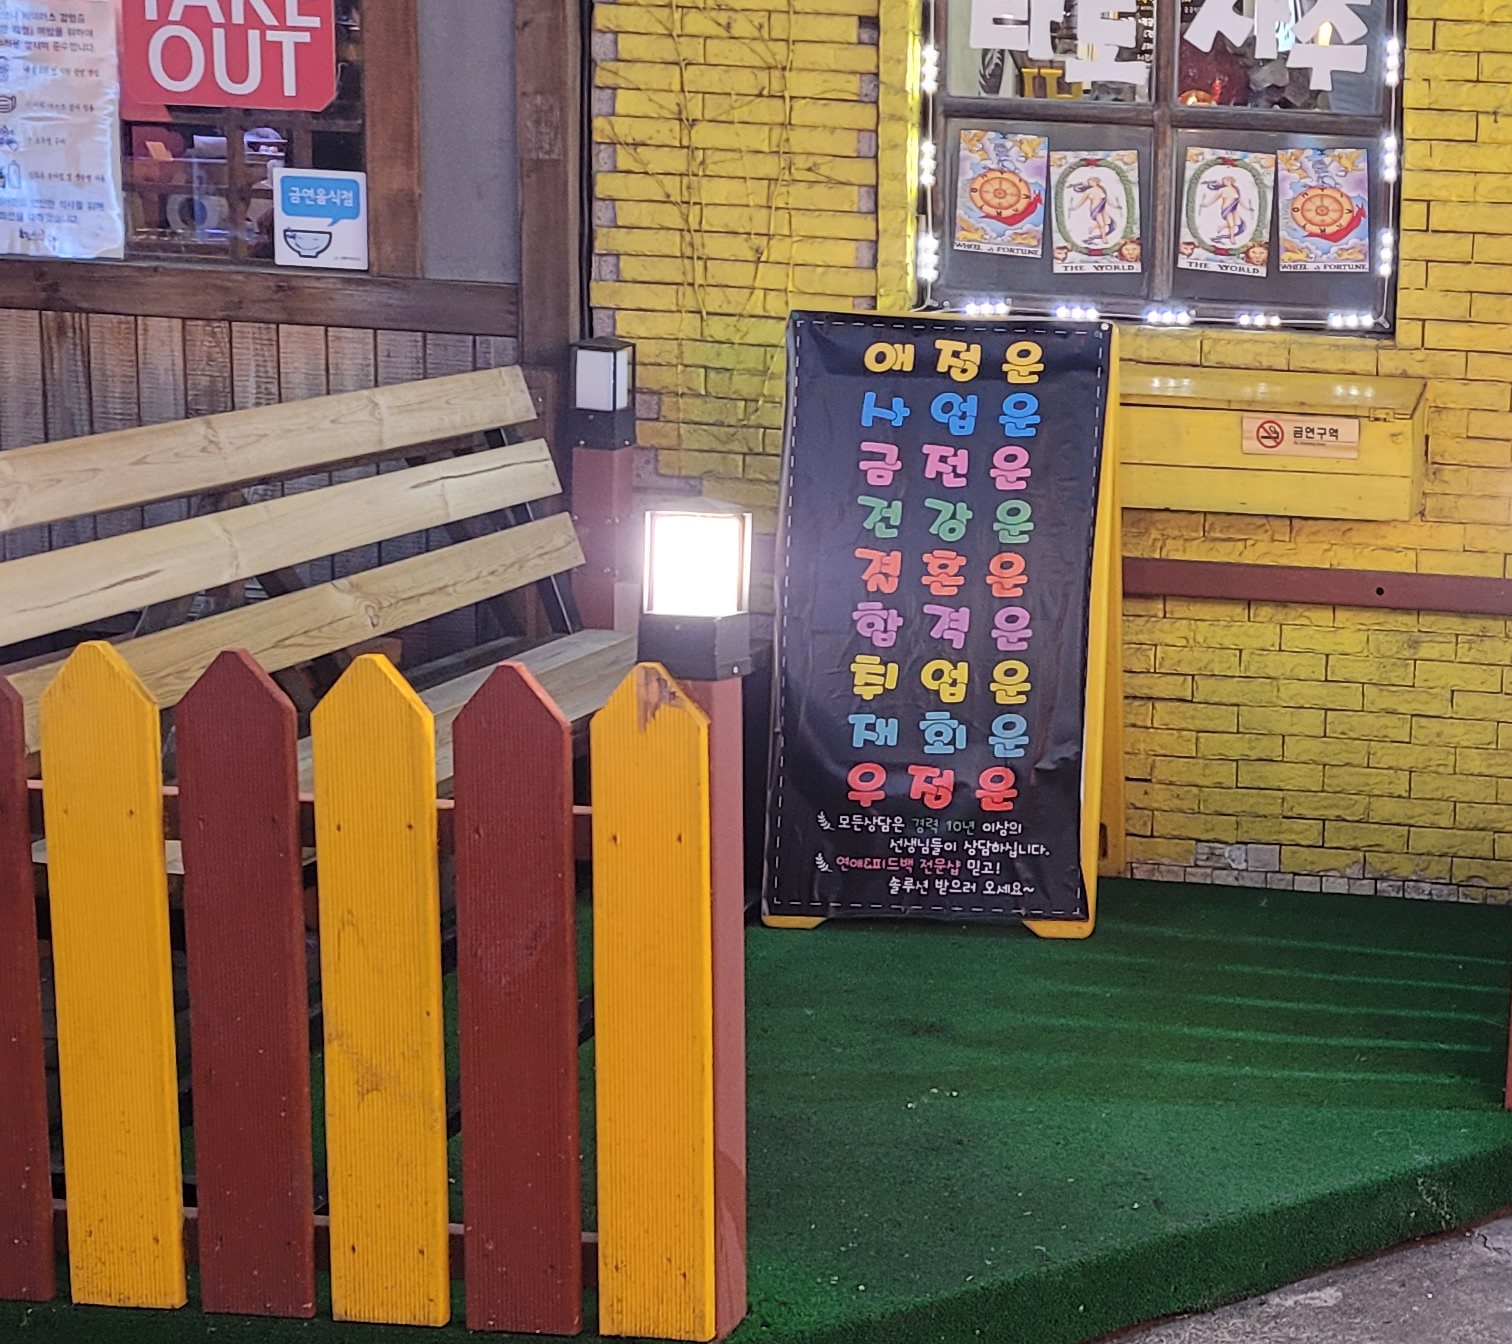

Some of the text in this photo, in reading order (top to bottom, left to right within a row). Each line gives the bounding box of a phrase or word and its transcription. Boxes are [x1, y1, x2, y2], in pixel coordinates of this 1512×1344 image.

[148, 24, 311, 97] OUT
[288, 186, 354, 208] 금연음식점
[1062, 264, 1086, 272] THE
[1186, 260, 1211, 270] THE
[1293, 425, 1340, 441] 금연구역
[838, 814, 1023, 837] 모든상담은 경력 10년 이상의
[889, 837, 1051, 859] 선생님들이 상담하십니다.
[919, 858, 962, 876] 전문샵
[966, 859, 1001, 877] 믿고!
[888, 876, 929, 895] 솔루션
[934, 878, 977, 896] 받으러
